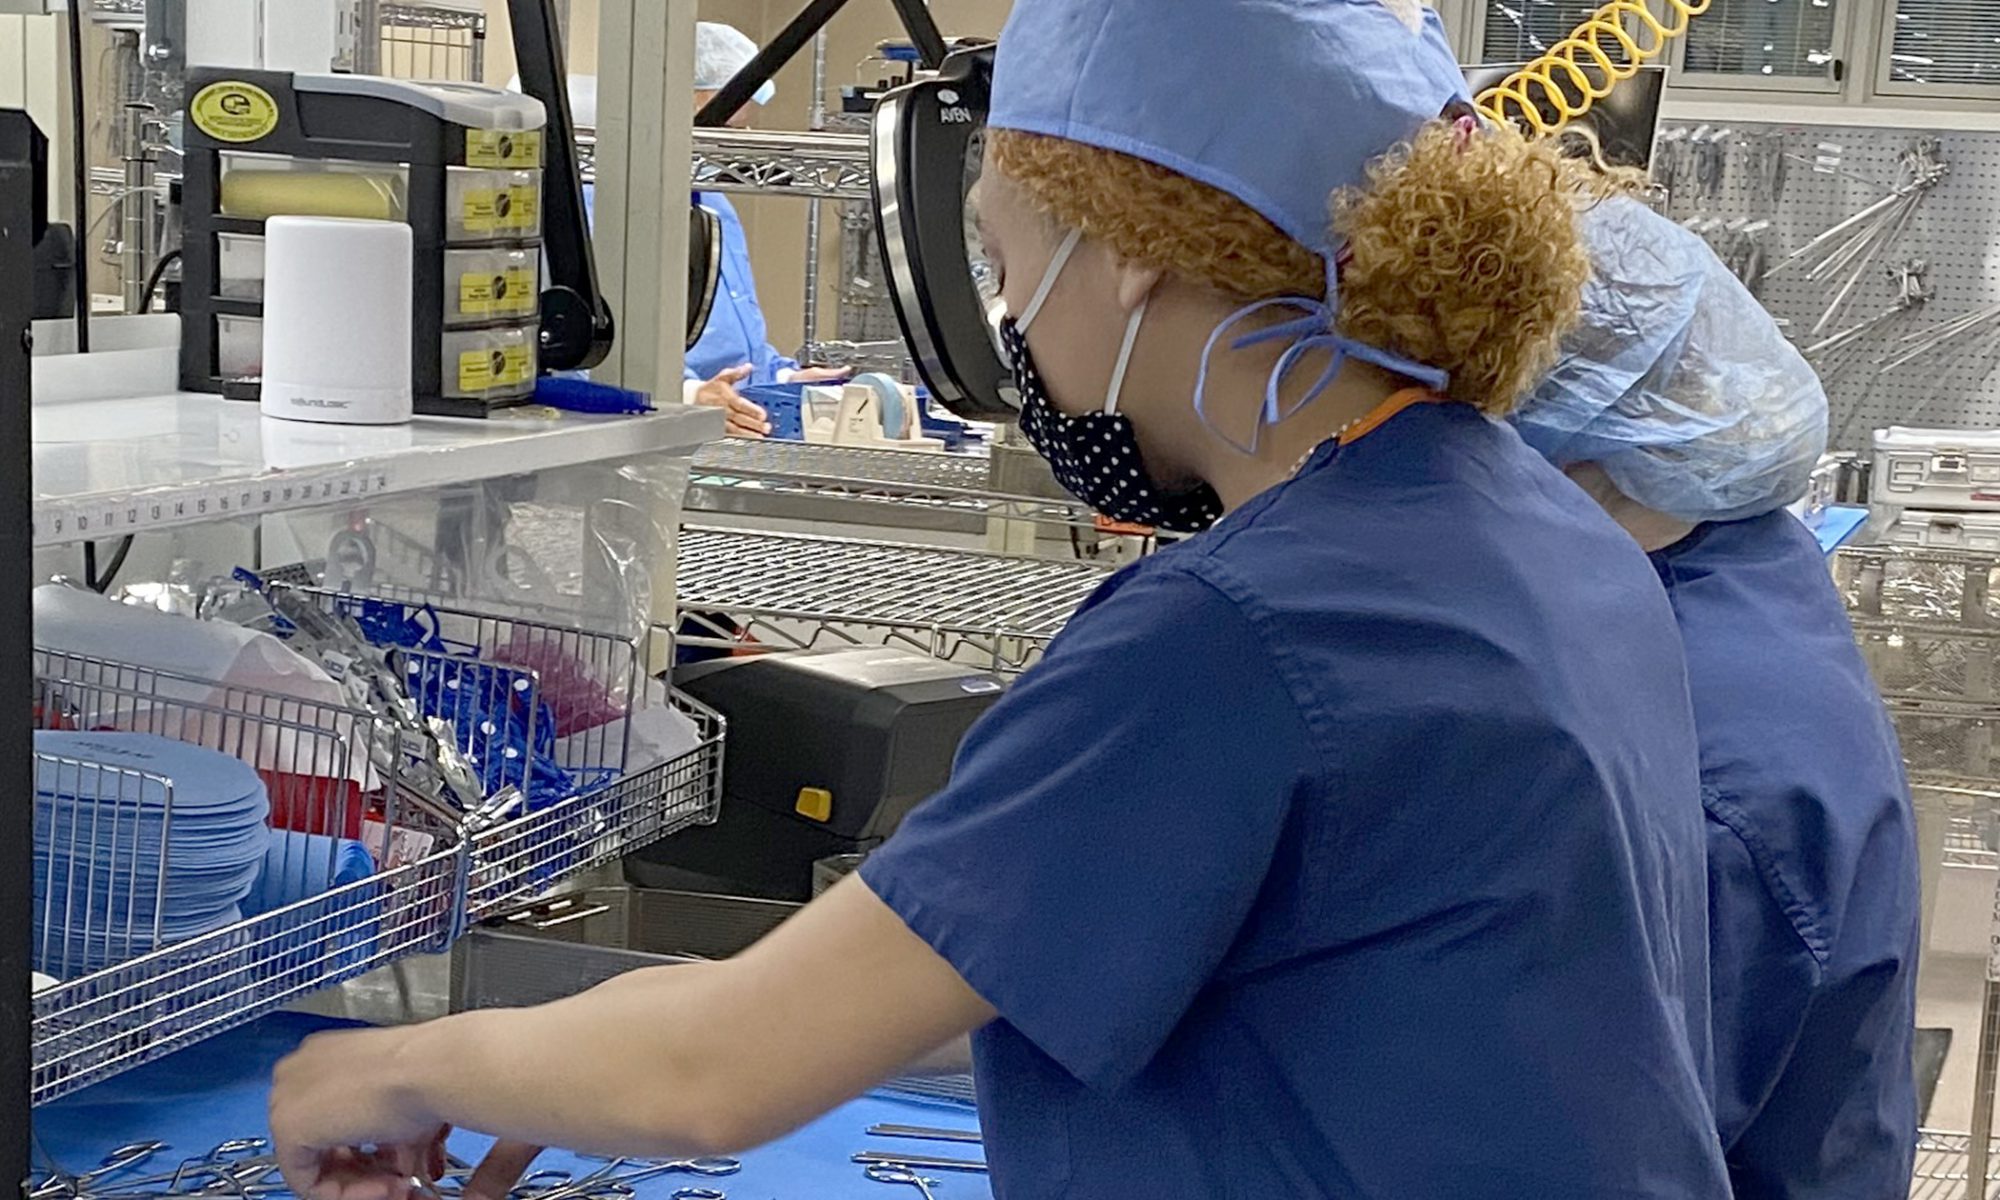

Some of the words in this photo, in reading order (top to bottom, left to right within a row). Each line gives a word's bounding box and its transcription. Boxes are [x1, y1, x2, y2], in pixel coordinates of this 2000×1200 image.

[941, 106, 972, 122] AVEN
[78, 516, 88, 530] 10
[104, 513, 113, 526] 11
[127, 509, 137, 523] 12
[150, 506, 160, 519] 13
[174, 503, 183, 516] 14
[197, 500, 206, 513] 15
